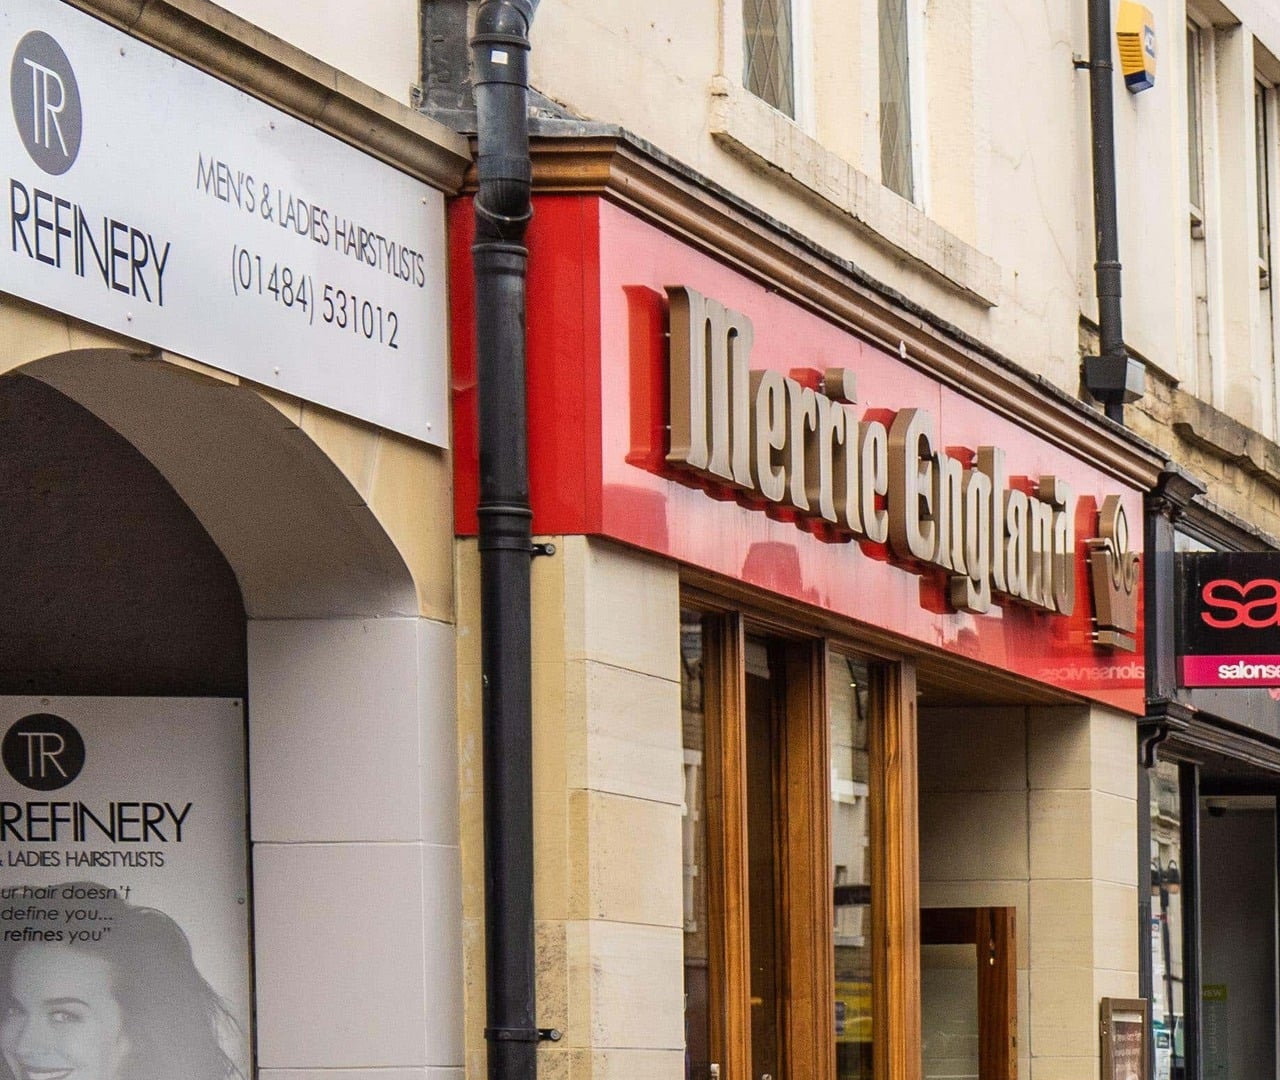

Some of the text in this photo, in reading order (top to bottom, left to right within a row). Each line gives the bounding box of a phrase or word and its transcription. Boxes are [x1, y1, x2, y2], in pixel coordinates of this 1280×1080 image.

[196, 150, 426, 289] MEN'S & LADIES HAIRSTYLISTS
[9, 177, 172, 307] REFINERY
[230, 244, 399, 350] (01484) 531012
[664, 284, 1076, 615] Merrie England
[0, 802, 193, 843] REFINERY
[8, 851, 165, 867] LADIES HAIRSTYLISTS
[22, 885, 58, 900] hair
[61, 885, 132, 900] doesn't
[1, 906, 113, 924] define you...
[4, 927, 63, 942] refines
